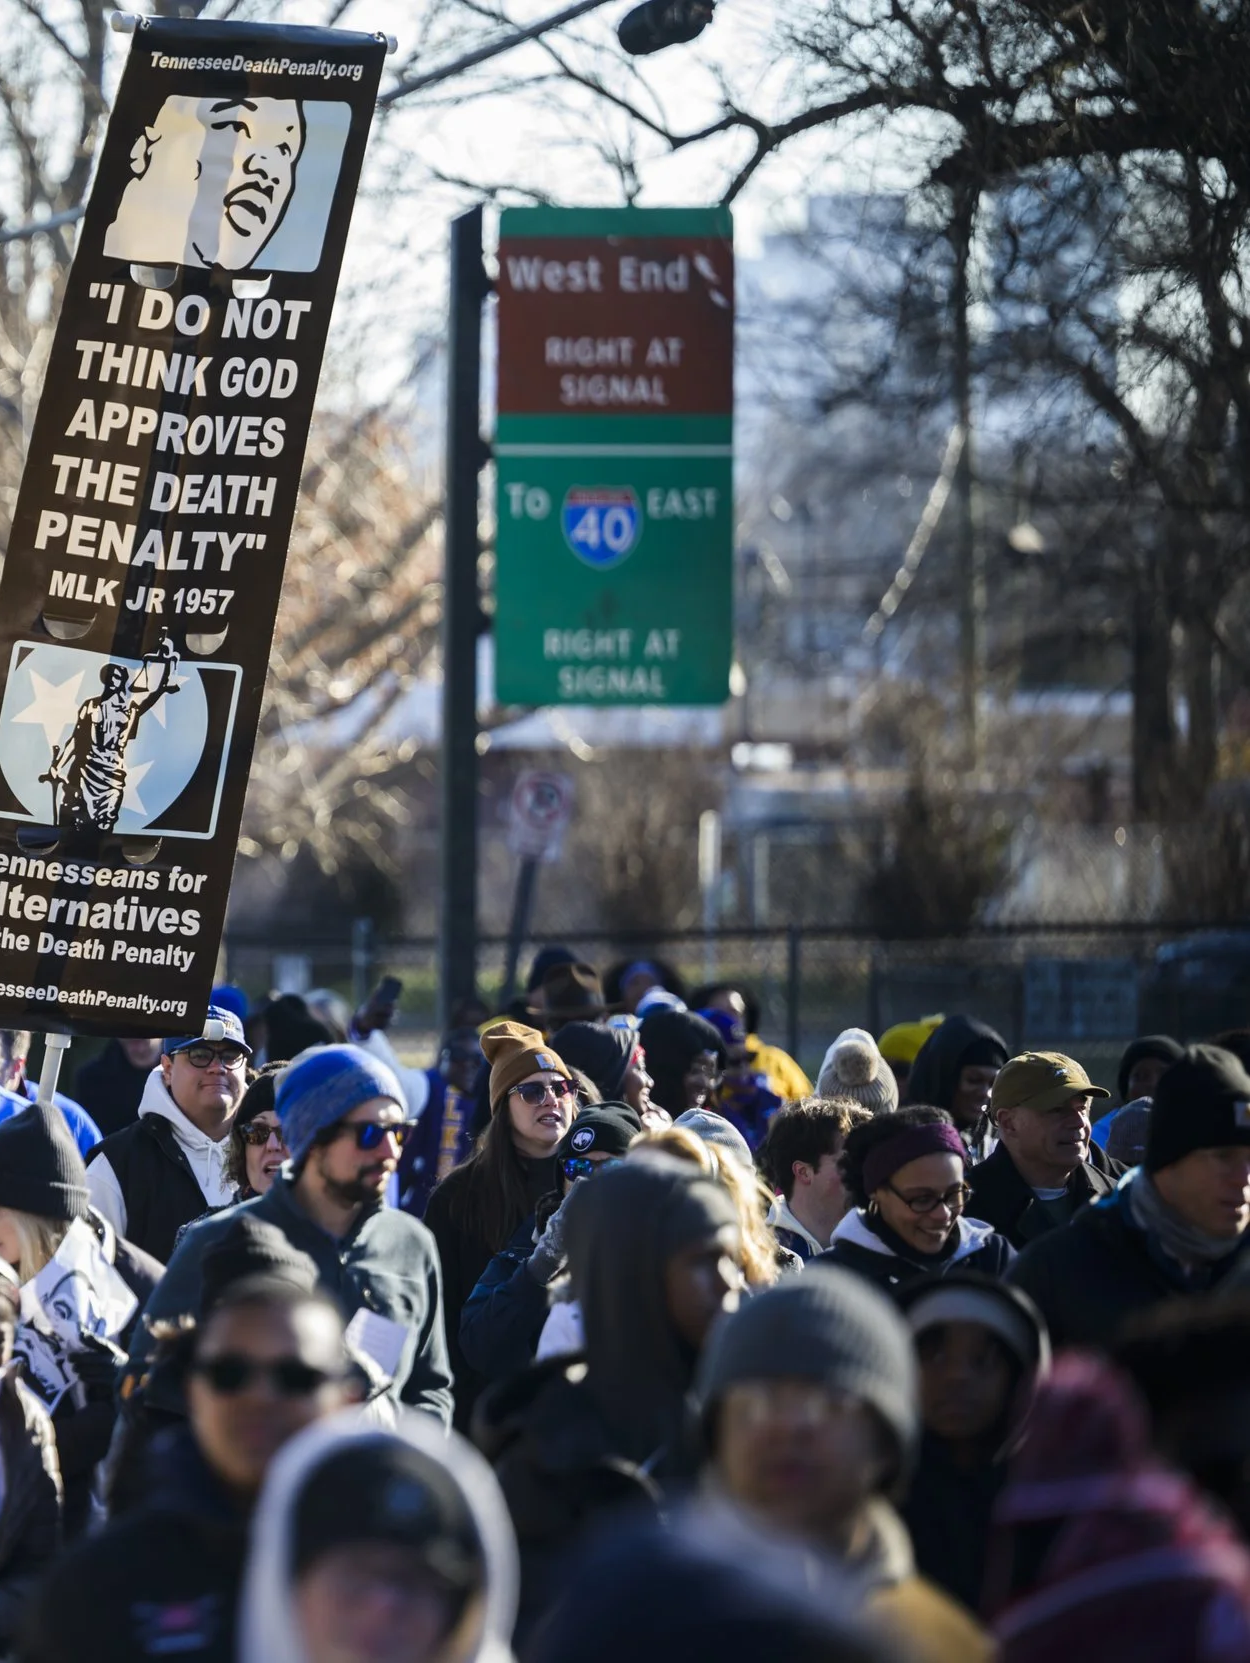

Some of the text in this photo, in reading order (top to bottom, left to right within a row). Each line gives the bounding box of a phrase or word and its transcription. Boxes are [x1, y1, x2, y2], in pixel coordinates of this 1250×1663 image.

[150, 51, 364, 81] TennesseeDeathPenalty.org
[507, 254, 689, 292] West End
[89, 282, 312, 340] "I DO NOT
[75, 339, 299, 399] THINK GOD
[545, 336, 684, 367] RIGHT AT
[560, 374, 669, 406] SIGNAL
[65, 398, 286, 458] APPROVES
[51, 454, 277, 517] THE DEATH
[505, 482, 551, 520] To
[571, 507, 633, 552] 40
[647, 487, 719, 519] EAST
[34, 509, 267, 572] PENALTY"
[48, 570, 235, 615] MLK JR 1957
[543, 628, 681, 660] RIGHT AT
[558, 665, 666, 698] SIGNAL
[168, 865, 207, 894] for
[37, 932, 105, 960] Death
[111, 940, 195, 973] Penalty
